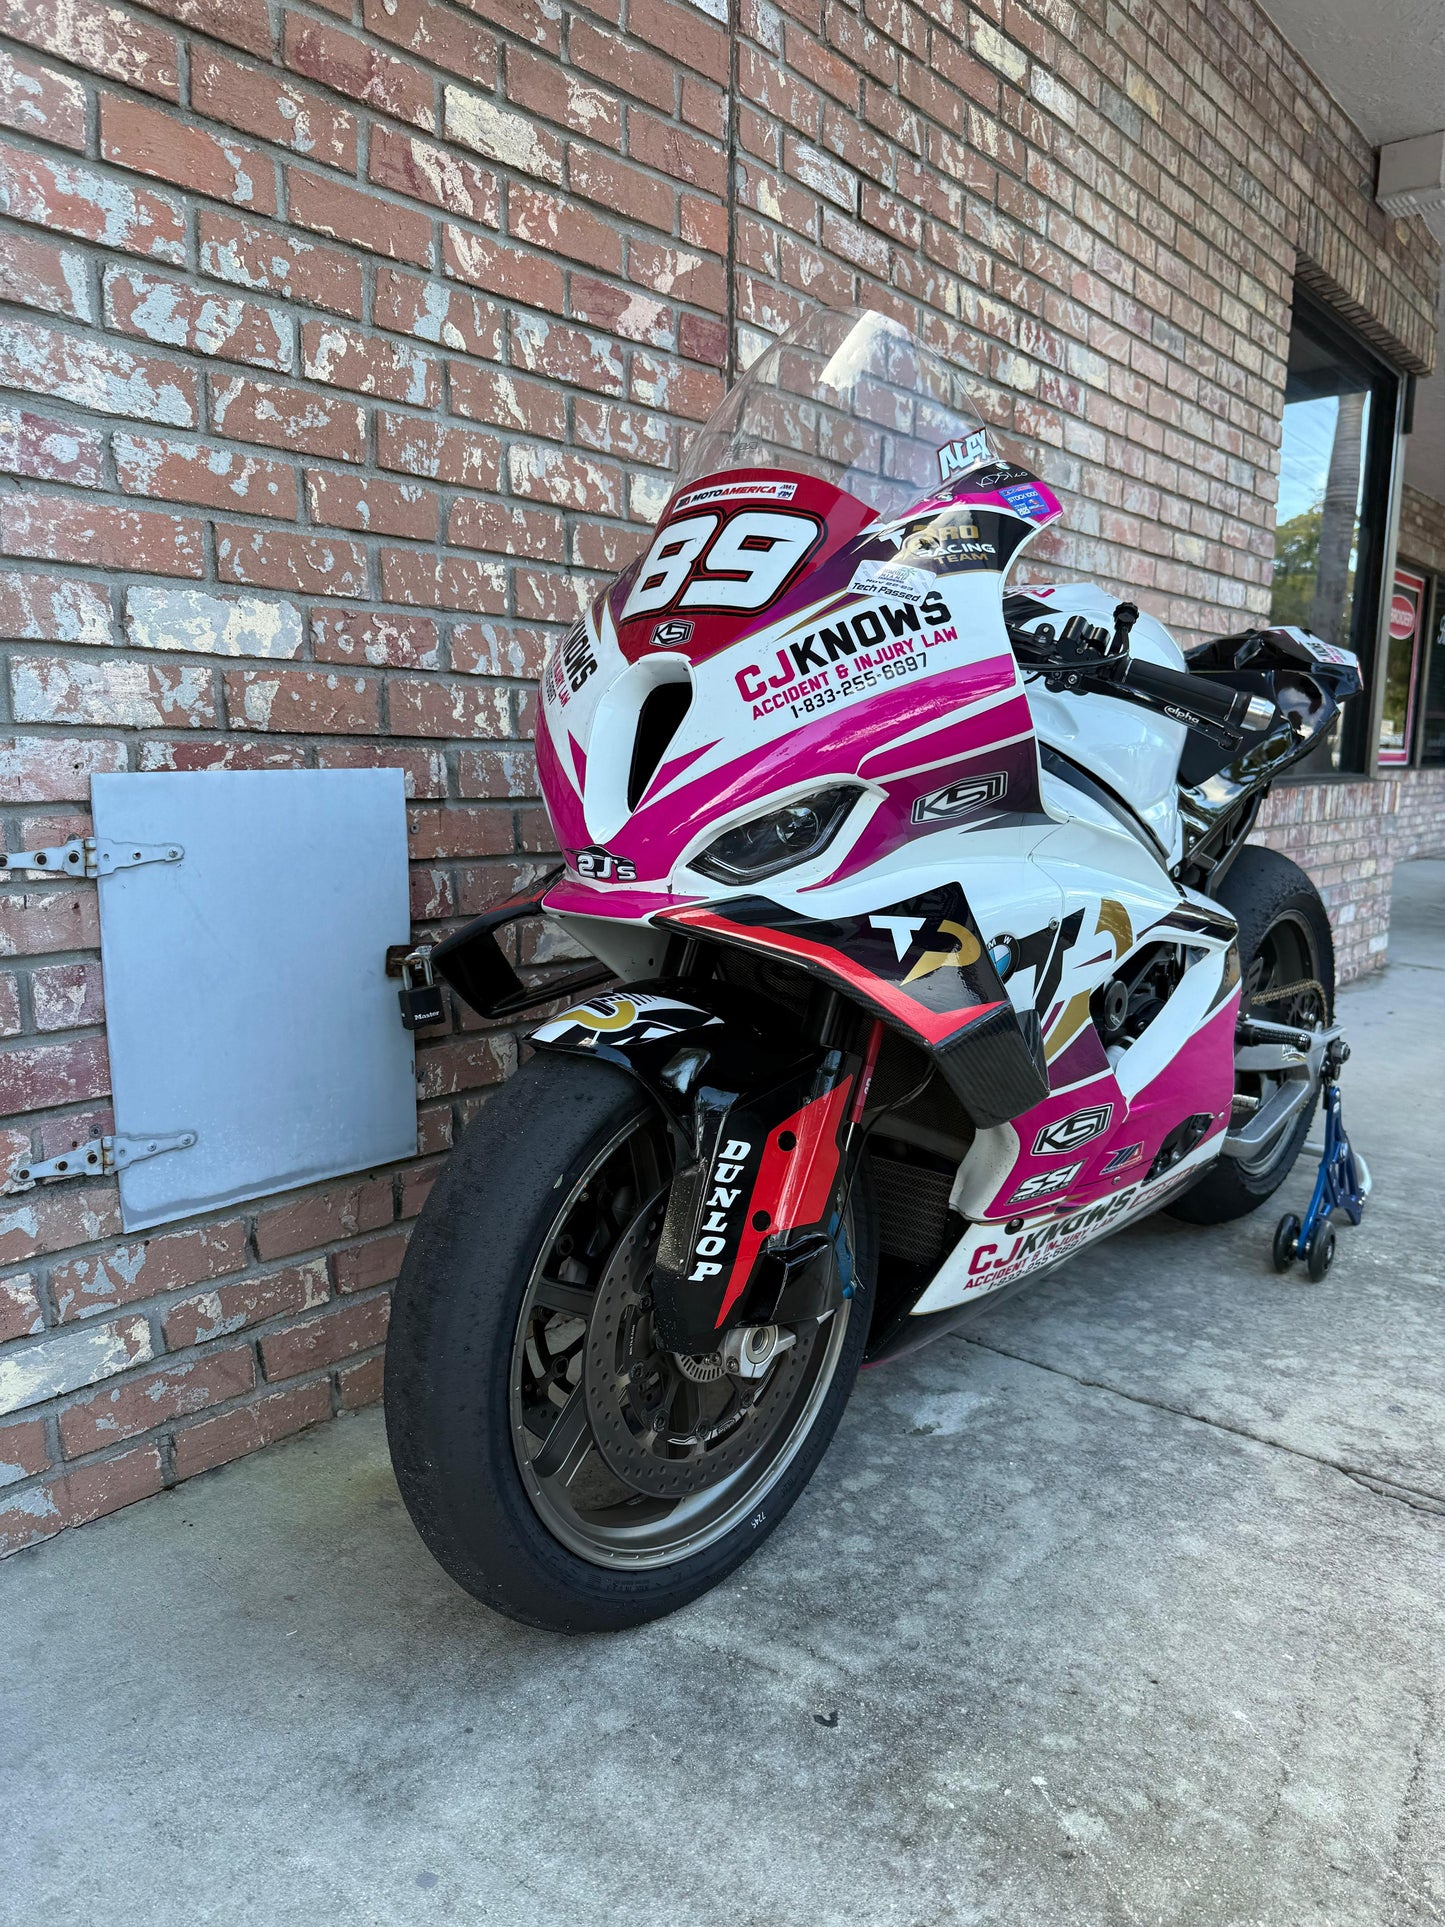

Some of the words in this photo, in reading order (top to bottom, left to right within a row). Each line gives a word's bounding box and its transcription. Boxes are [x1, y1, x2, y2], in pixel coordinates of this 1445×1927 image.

[938, 430, 992, 482] ALEX
[691, 485, 778, 503] MOTOAMERICA
[619, 511, 820, 623] 89
[933, 552, 989, 565] TEAM
[852, 582, 878, 593] Tech
[878, 585, 922, 602] Passed
[752, 671, 836, 721] ACCIDENT
[835, 664, 849, 680] &
[853, 637, 915, 673] INJURY
[920, 626, 959, 649] LAW
[790, 652, 928, 719] 1-833-255-6697
[1167, 707, 1200, 724] alpha
[414, 1010, 440, 1021] Master
[1013, 1161, 1084, 1198] SSI
[687, 1138, 752, 1282] DUNLOP
[963, 1256, 1029, 1290] ACCIDENT
[1043, 1228, 1090, 1255] INJURY
